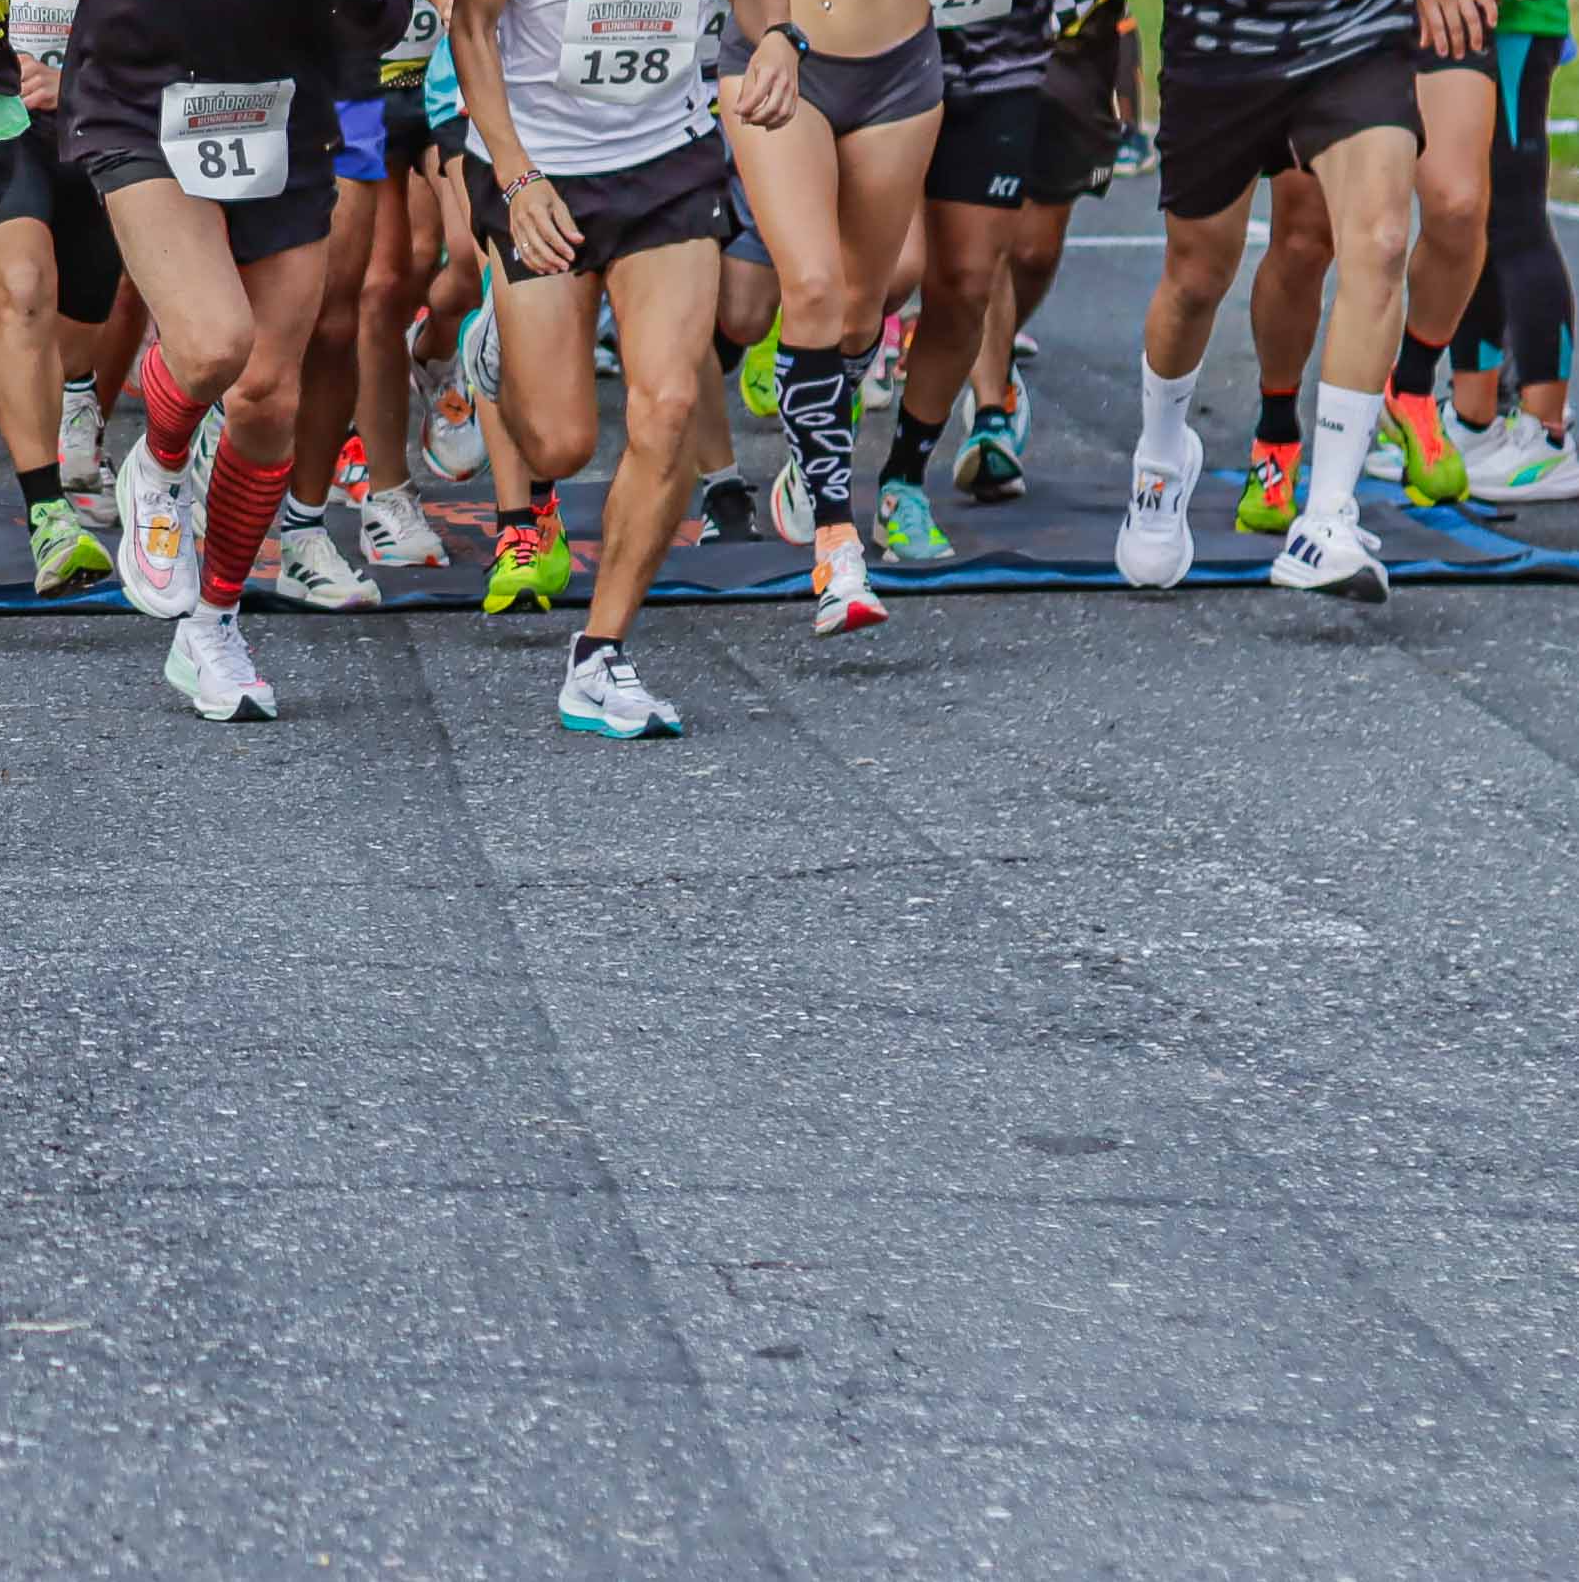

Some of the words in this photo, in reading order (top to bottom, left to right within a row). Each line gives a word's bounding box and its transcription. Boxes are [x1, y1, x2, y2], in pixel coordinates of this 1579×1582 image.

[580, 49, 670, 85] 138
[183, 91, 277, 116] AUTÓDROMO
[198, 138, 255, 179] 81
